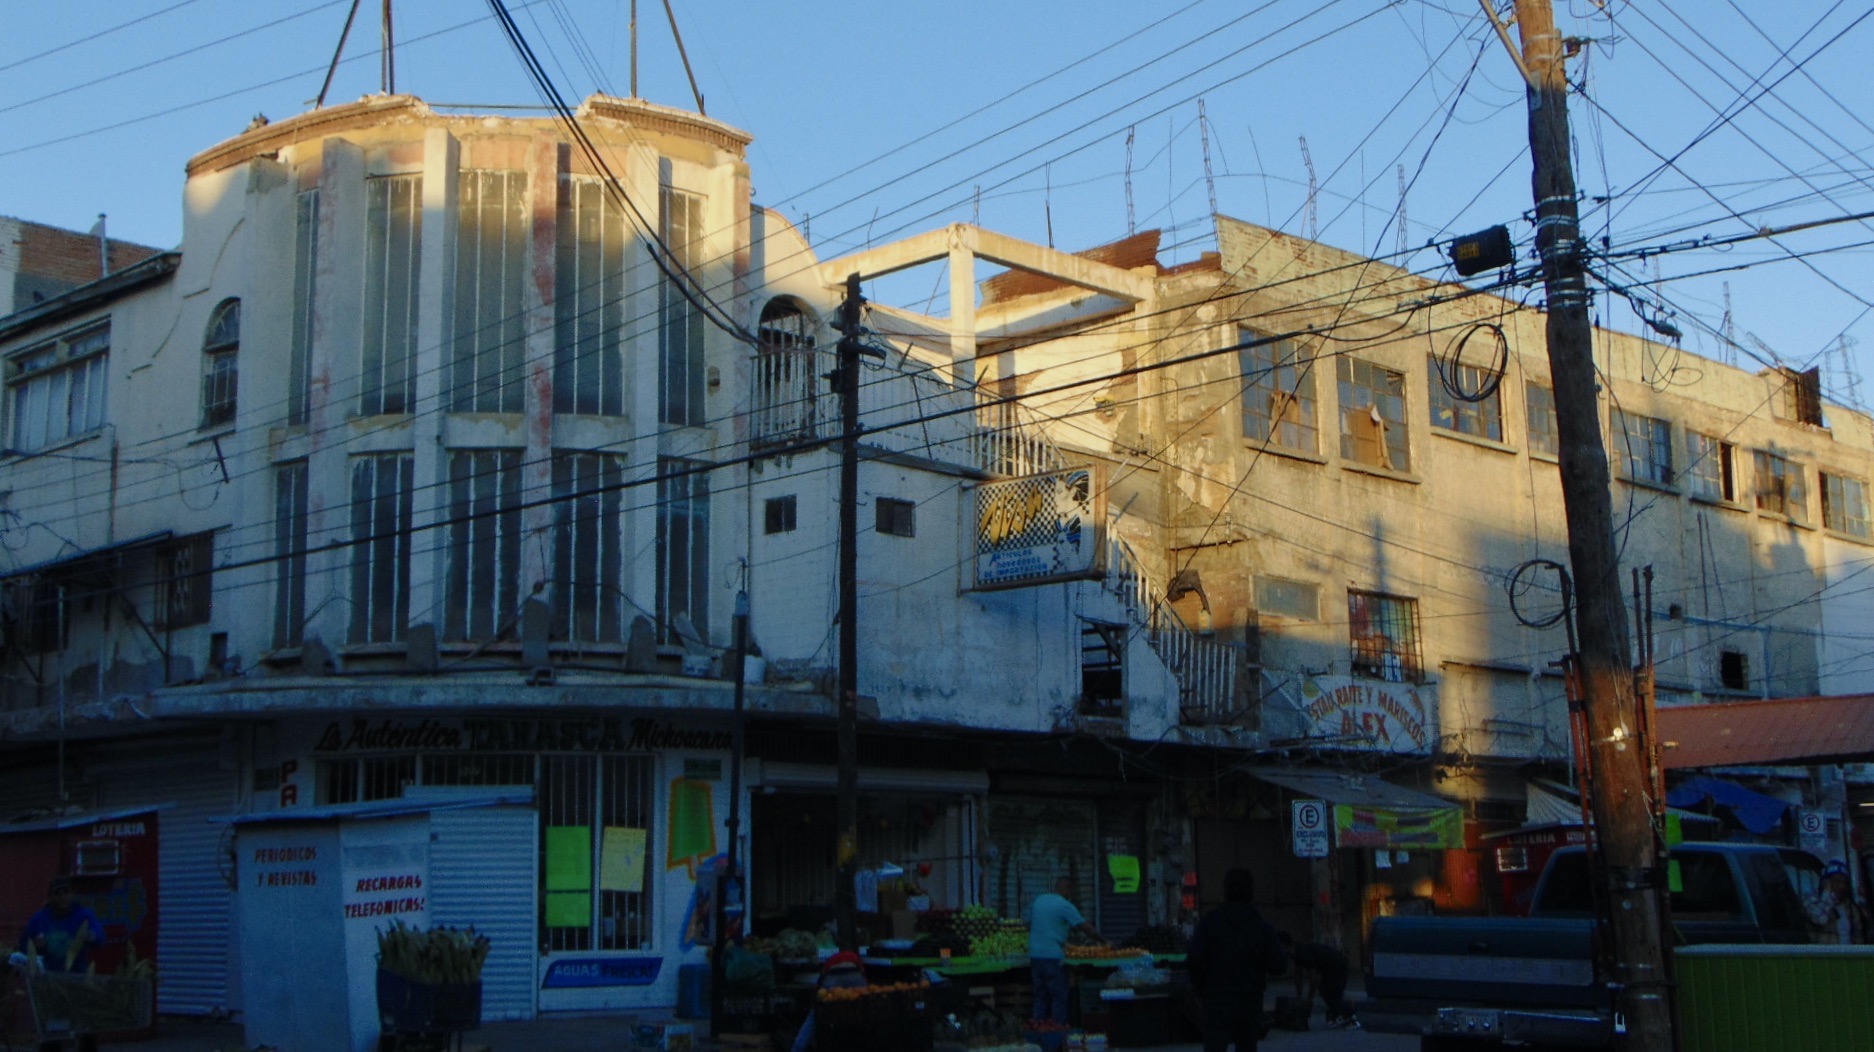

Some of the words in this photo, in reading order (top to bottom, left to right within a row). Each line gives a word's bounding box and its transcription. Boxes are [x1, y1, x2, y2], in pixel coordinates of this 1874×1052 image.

[1378, 689, 1425, 751] MARISCOS
[315, 721, 342, 751] La
[1305, 809, 1314, 824] E
[1807, 817, 1815, 829] E
[92, 822, 146, 837] LOTERIA
[1507, 832, 1556, 845] LOTERIA
[254, 847, 318, 863] PERIODICOS
[268, 871, 318, 886] REVISTAS
[356, 875, 422, 893] RECARGAS
[554, 963, 599, 977] AGUAS
